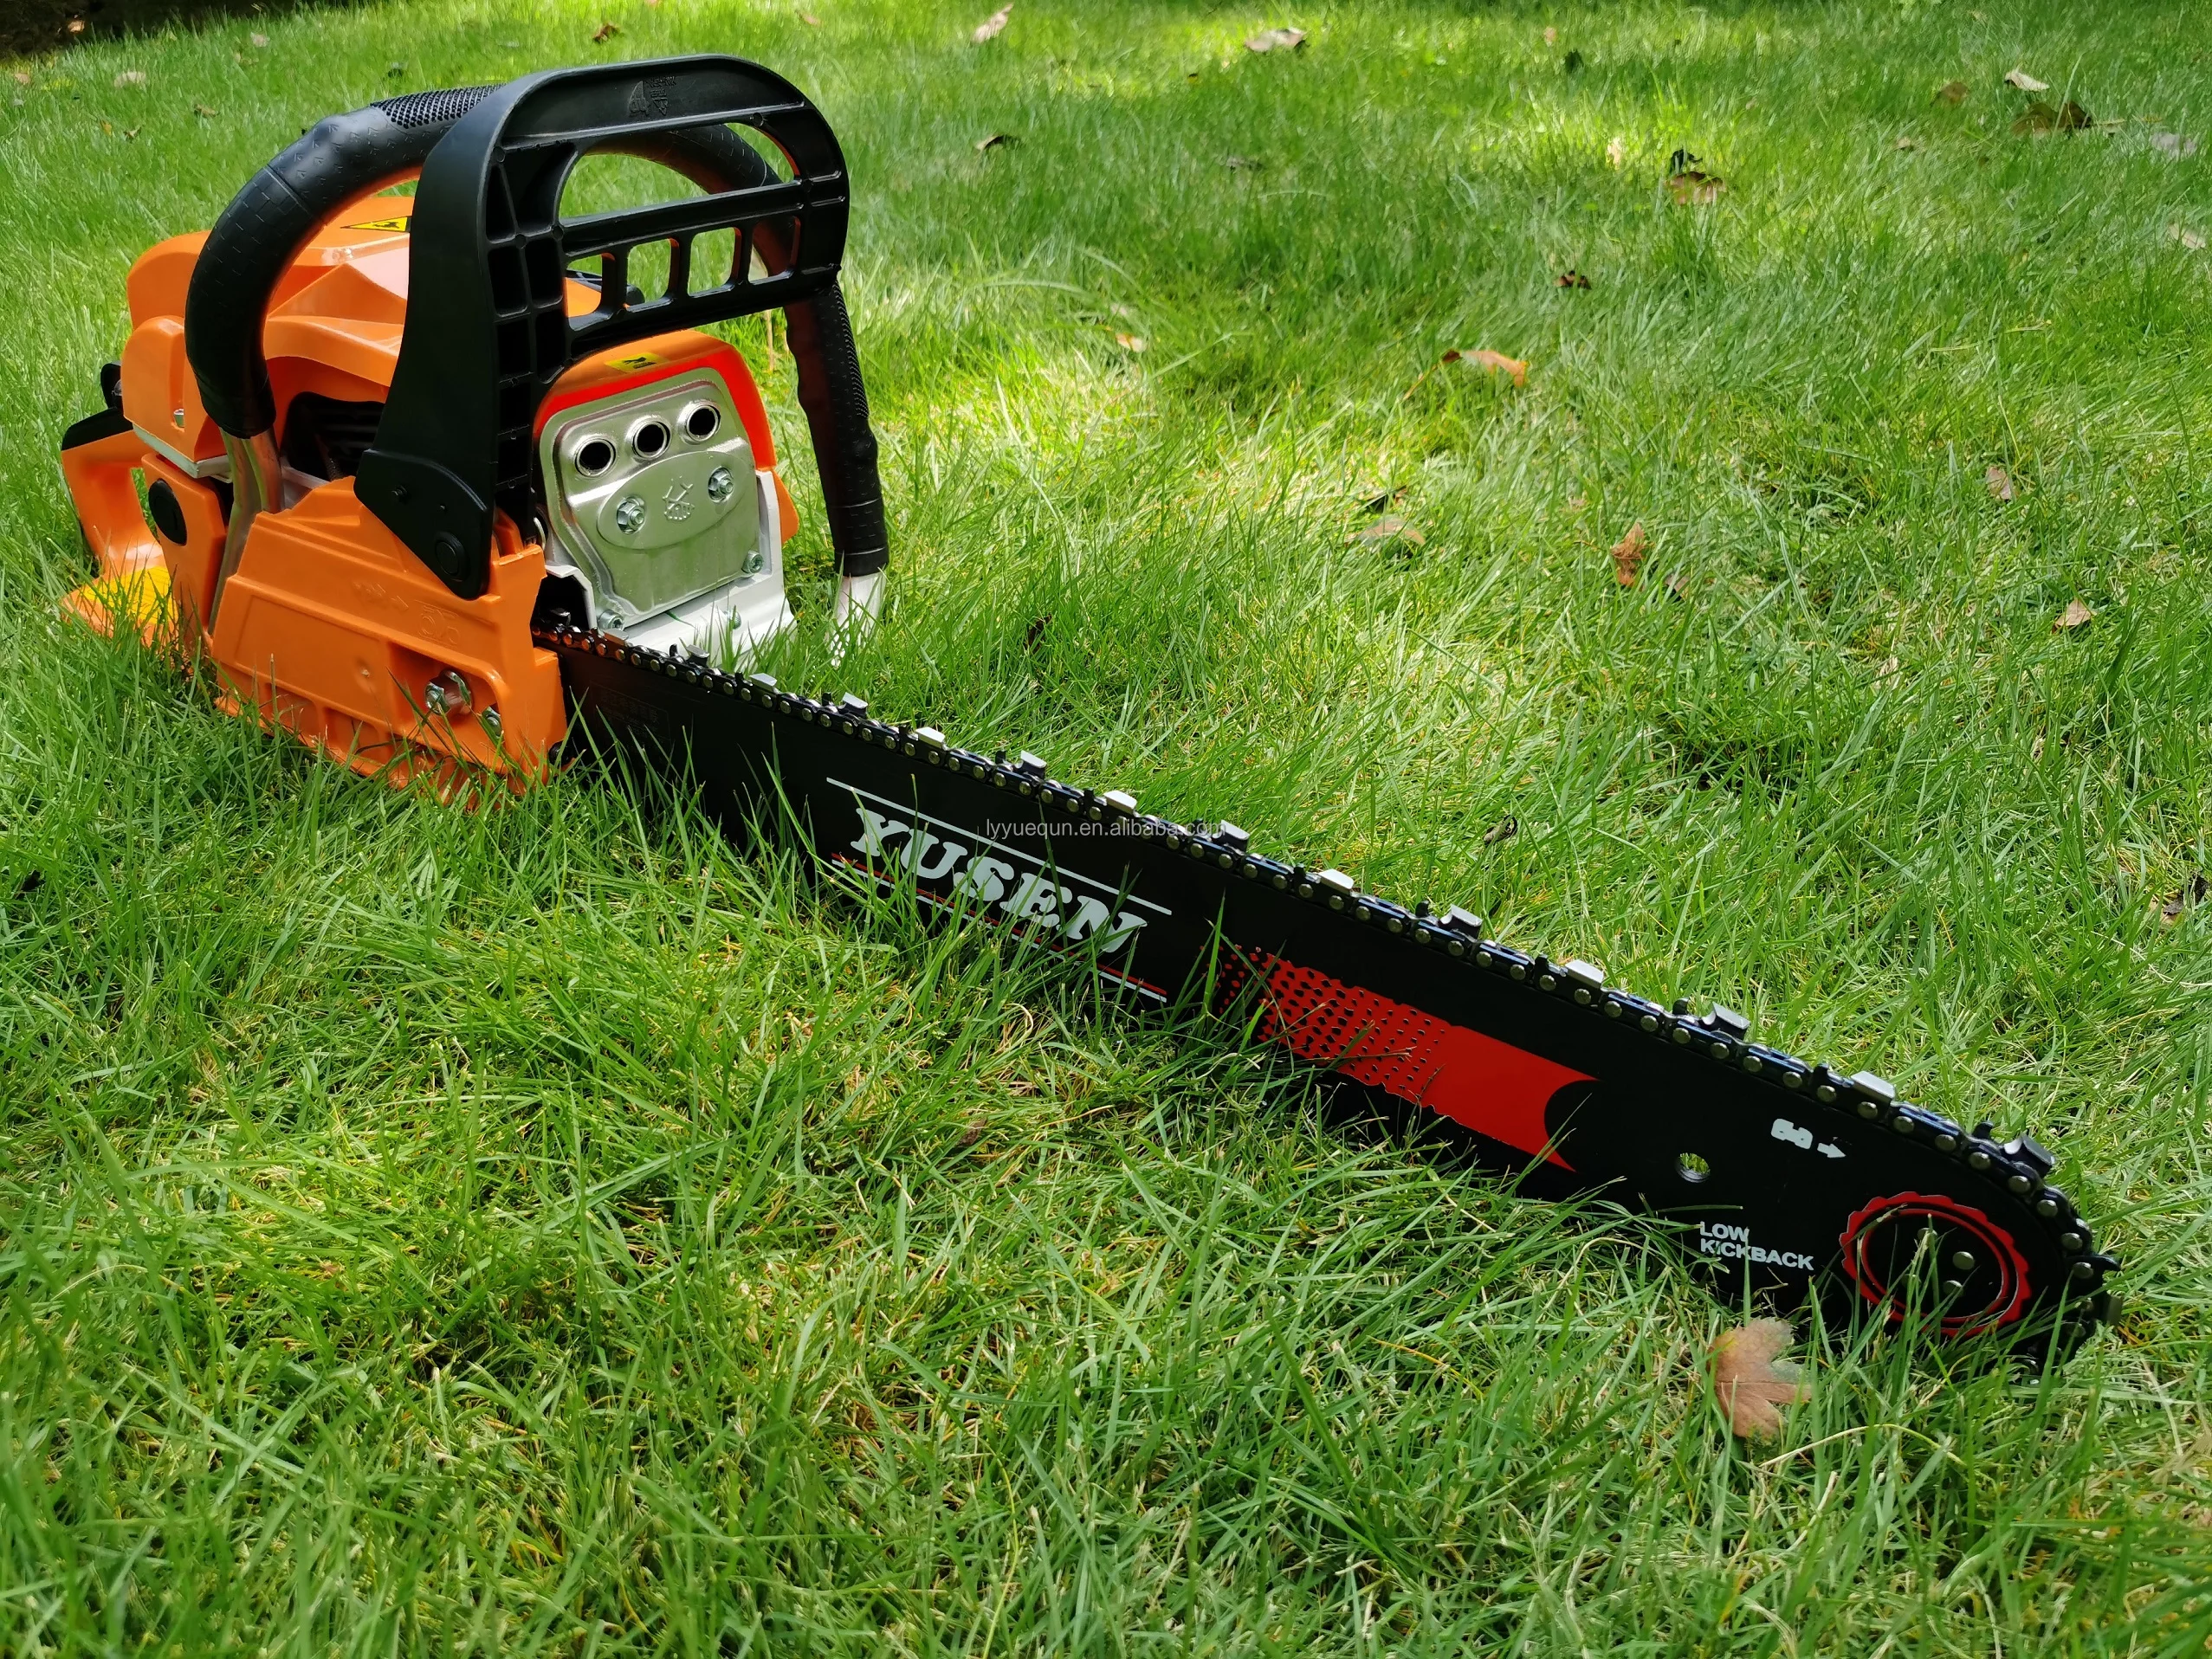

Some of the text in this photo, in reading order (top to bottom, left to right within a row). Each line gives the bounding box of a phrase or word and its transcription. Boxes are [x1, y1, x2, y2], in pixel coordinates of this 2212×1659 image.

[851, 808, 1148, 952] YUSEN
[1699, 1221, 1750, 1242] LOW
[1700, 1238, 1814, 1270] KICKBACK
